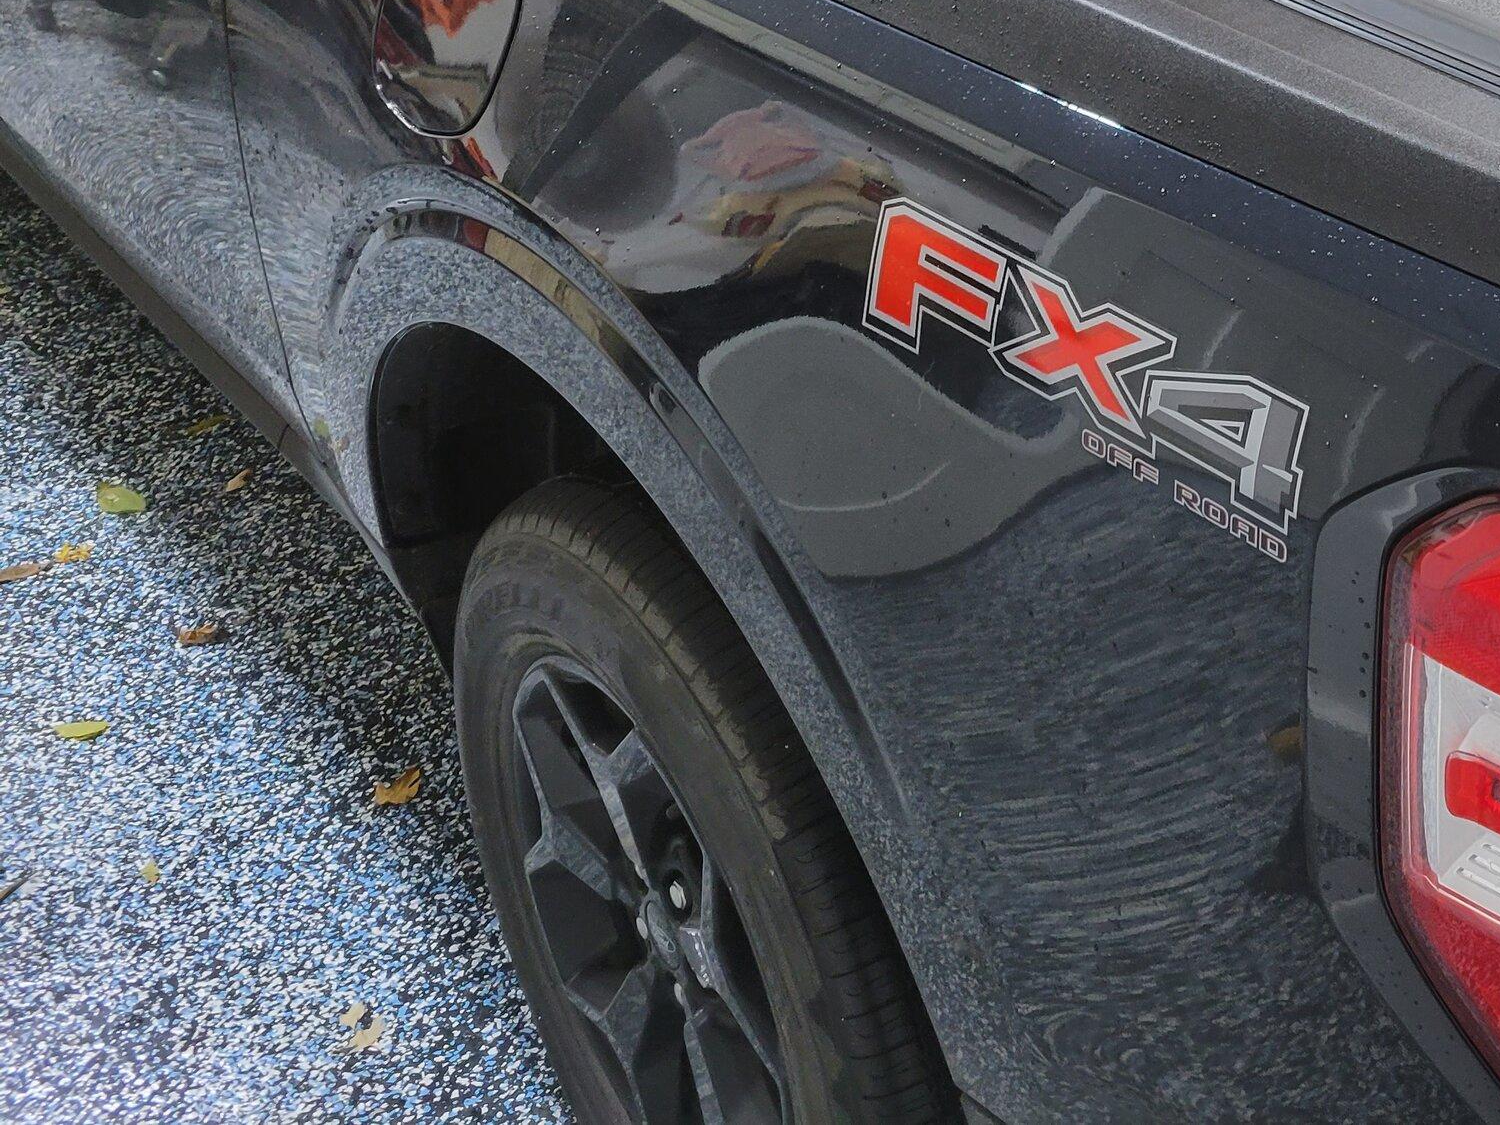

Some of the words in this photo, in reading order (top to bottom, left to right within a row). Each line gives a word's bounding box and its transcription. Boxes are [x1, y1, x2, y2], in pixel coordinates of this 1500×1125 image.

[862, 196, 1310, 535] FX4
[1080, 428, 1160, 485] OFF
[1172, 478, 1288, 564] ROAD
